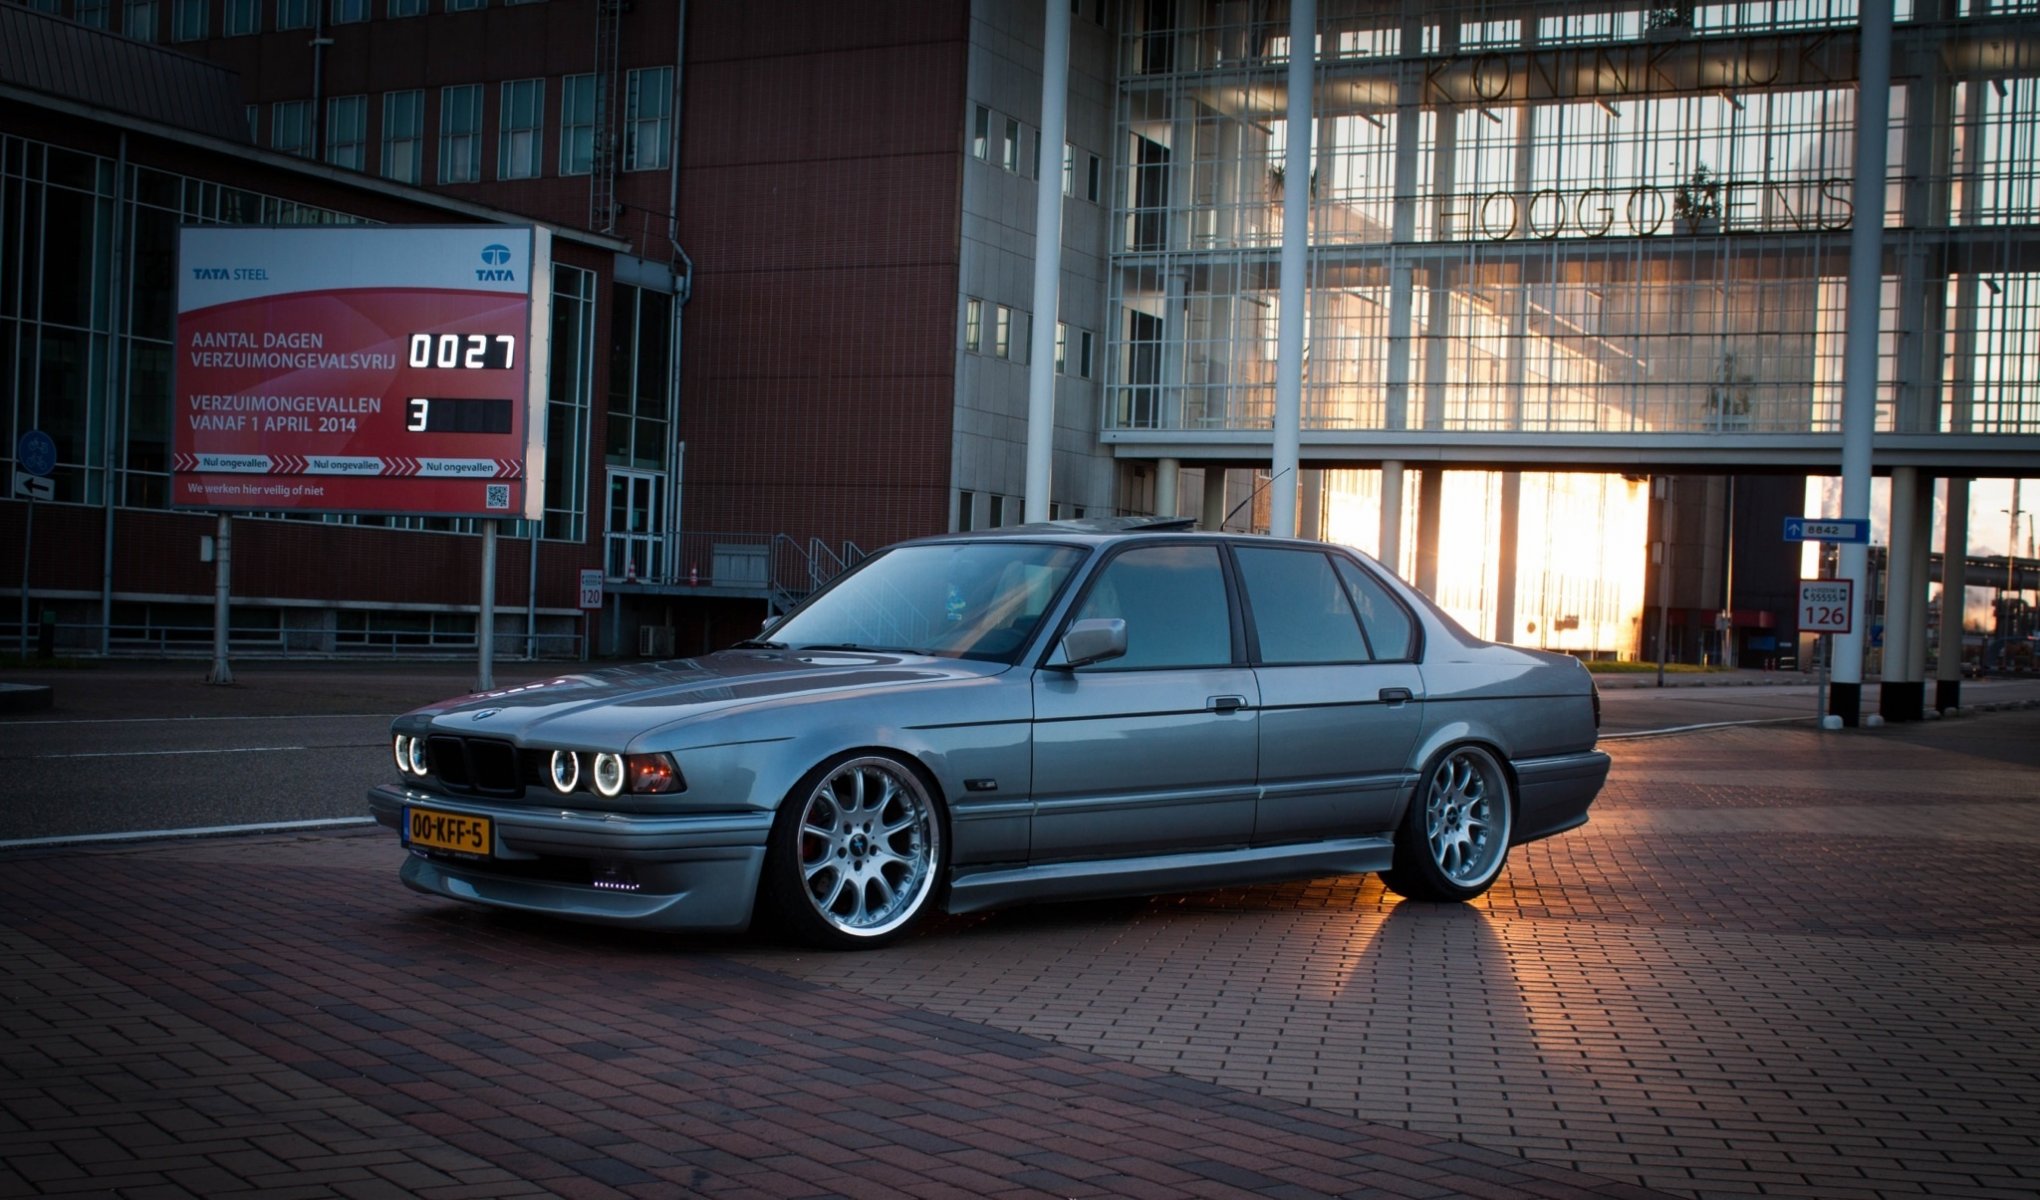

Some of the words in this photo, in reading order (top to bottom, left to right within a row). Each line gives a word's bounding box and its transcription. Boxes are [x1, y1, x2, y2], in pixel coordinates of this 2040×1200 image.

[1438, 177, 1855, 242] HOOGOVENS
[193, 268, 229, 280] TATA
[234, 268, 268, 280] STEEL
[476, 270, 515, 281] TATA
[192, 332, 258, 348] AANTAL
[263, 333, 322, 348] DAGEN
[409, 334, 514, 368] 0027
[192, 352, 395, 369] VERZUIMONGEVALSVRIJ
[190, 396, 381, 412] VERZUIMONGEVALLEN
[189, 415, 246, 431] VANAF
[252, 416, 258, 431] 1
[264, 416, 312, 432] APRIL
[319, 417, 356, 432] 2014
[408, 399, 428, 432] 3
[203, 458, 218, 468] Nul
[220, 458, 267, 470] ongevallen
[314, 460, 329, 469] Nul
[331, 460, 379, 471] ongevallen
[426, 462, 442, 471] Nul
[443, 462, 493, 473] ongevallen
[188, 483, 203, 493] We
[205, 484, 240, 494] werken
[242, 484, 262, 494] hier
[264, 484, 290, 497] veilig
[292, 485, 303, 495] of
[305, 486, 323, 496] niet
[1807, 526, 1839, 535] 8842
[582, 589, 600, 604] 120
[1806, 606, 1845, 625] 126
[412, 813, 483, 848] 00-KFF-5
